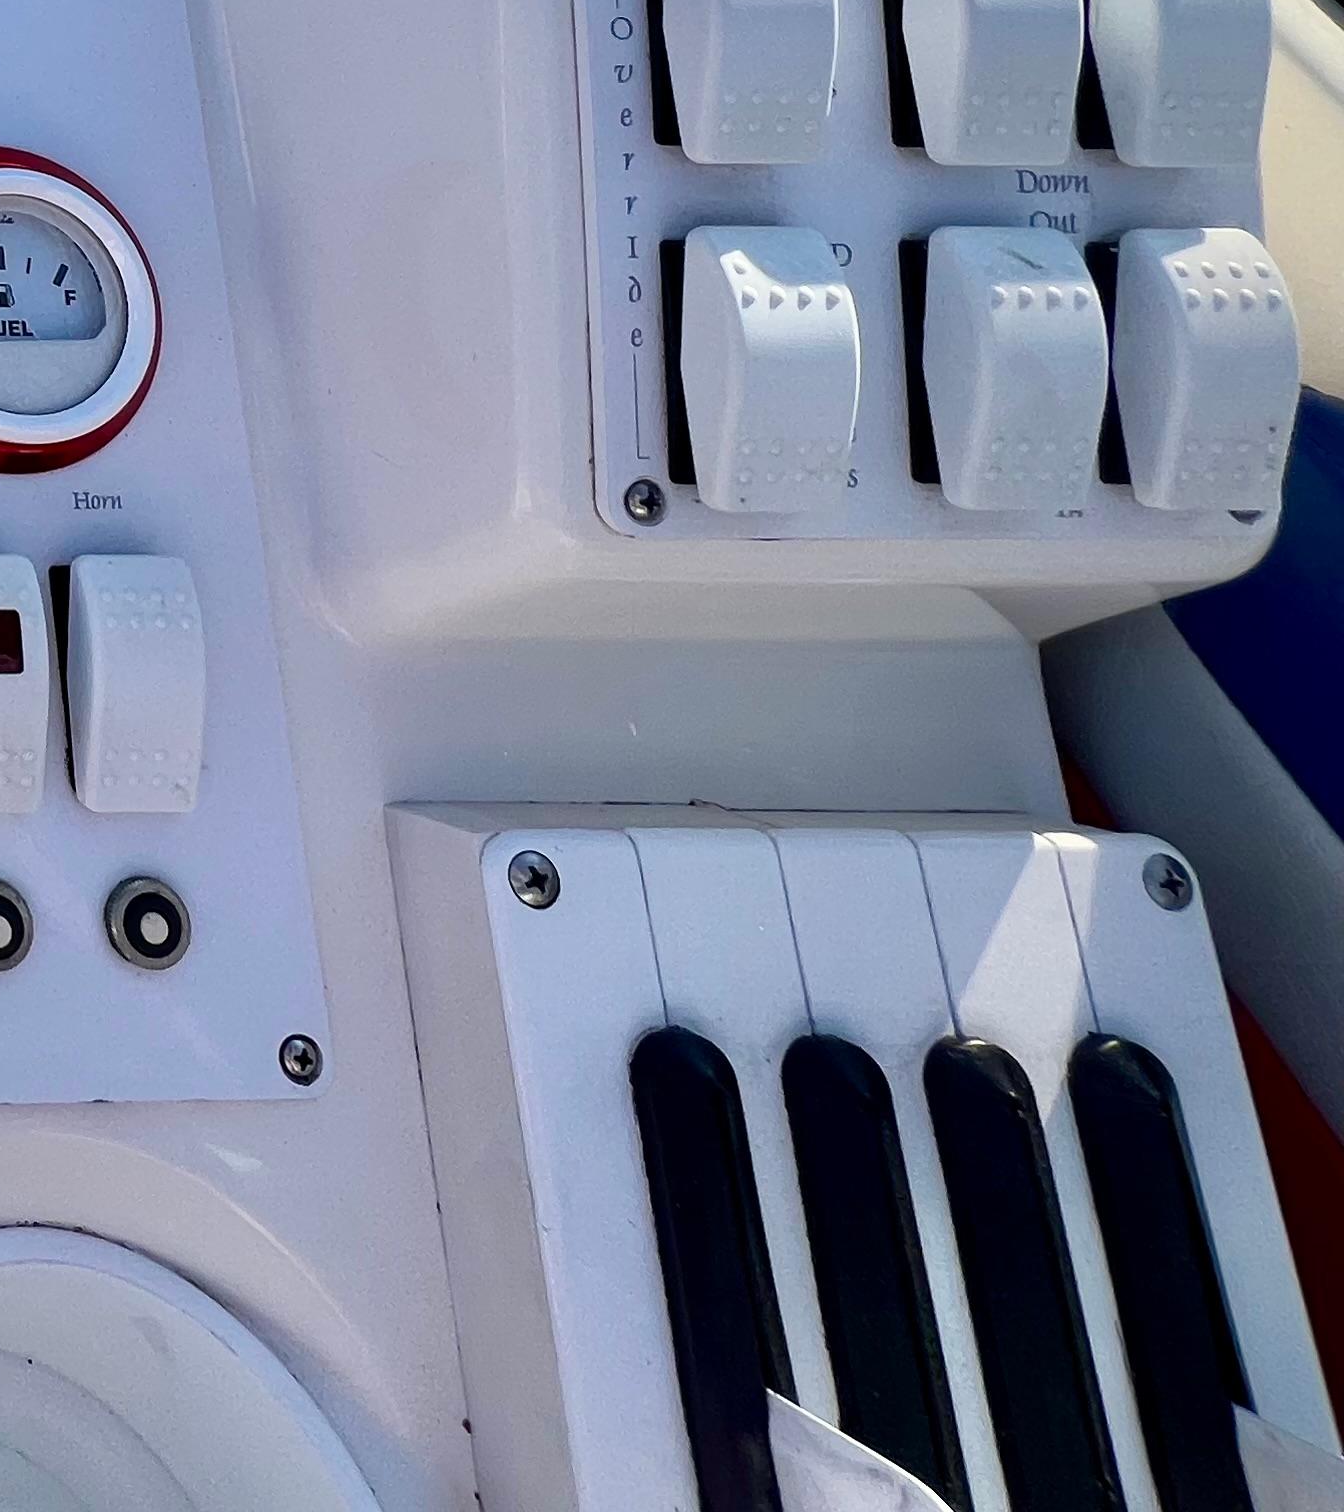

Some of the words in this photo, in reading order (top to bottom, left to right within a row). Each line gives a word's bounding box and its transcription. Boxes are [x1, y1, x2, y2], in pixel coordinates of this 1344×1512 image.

[1015, 170, 1089, 194] Down
[64, 289, 77, 306] F
[72, 491, 122, 510] Horn
